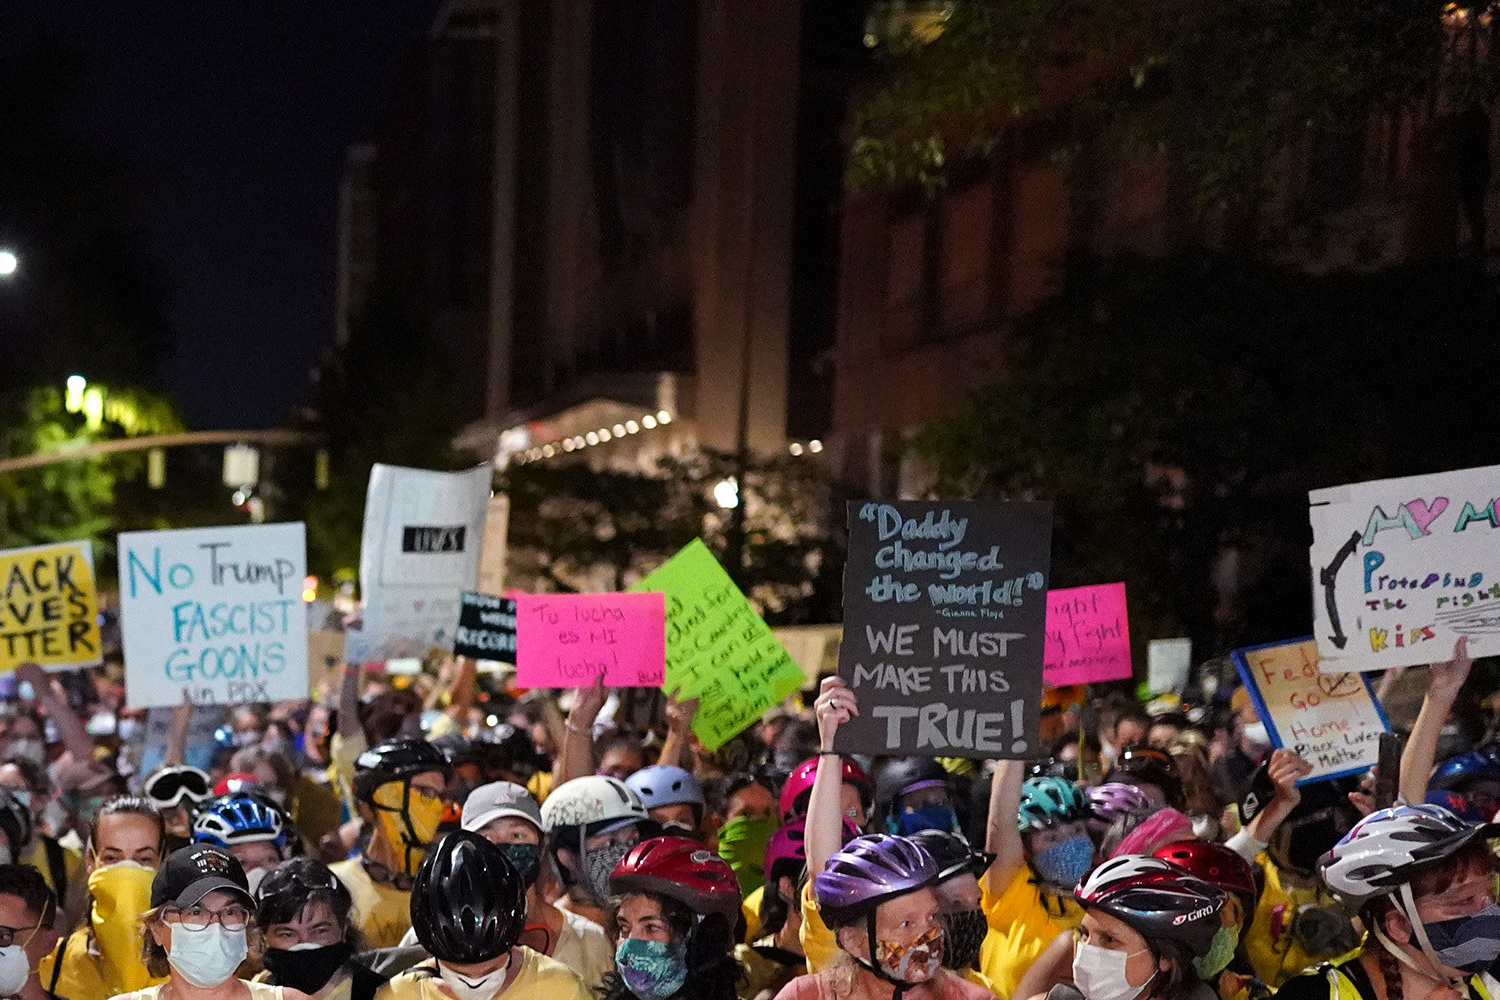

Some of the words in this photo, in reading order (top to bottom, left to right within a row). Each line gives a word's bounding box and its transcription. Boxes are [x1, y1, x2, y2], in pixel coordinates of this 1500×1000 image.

[128, 547, 195, 598] No
[197, 541, 296, 596] Trump
[875, 542, 1004, 580] changed
[865, 573, 922, 603] the
[171, 599, 297, 643] FASCIST
[574, 604, 625, 622] lucha
[866, 622, 921, 656] WE
[933, 626, 1027, 659] MUST
[164, 642, 286, 682] GOONS
[853, 662, 933, 696] MAKE
[940, 664, 1010, 693] THIS
[872, 699, 1028, 755] TRUE!
[1188, 905, 1213, 921] GIRO
